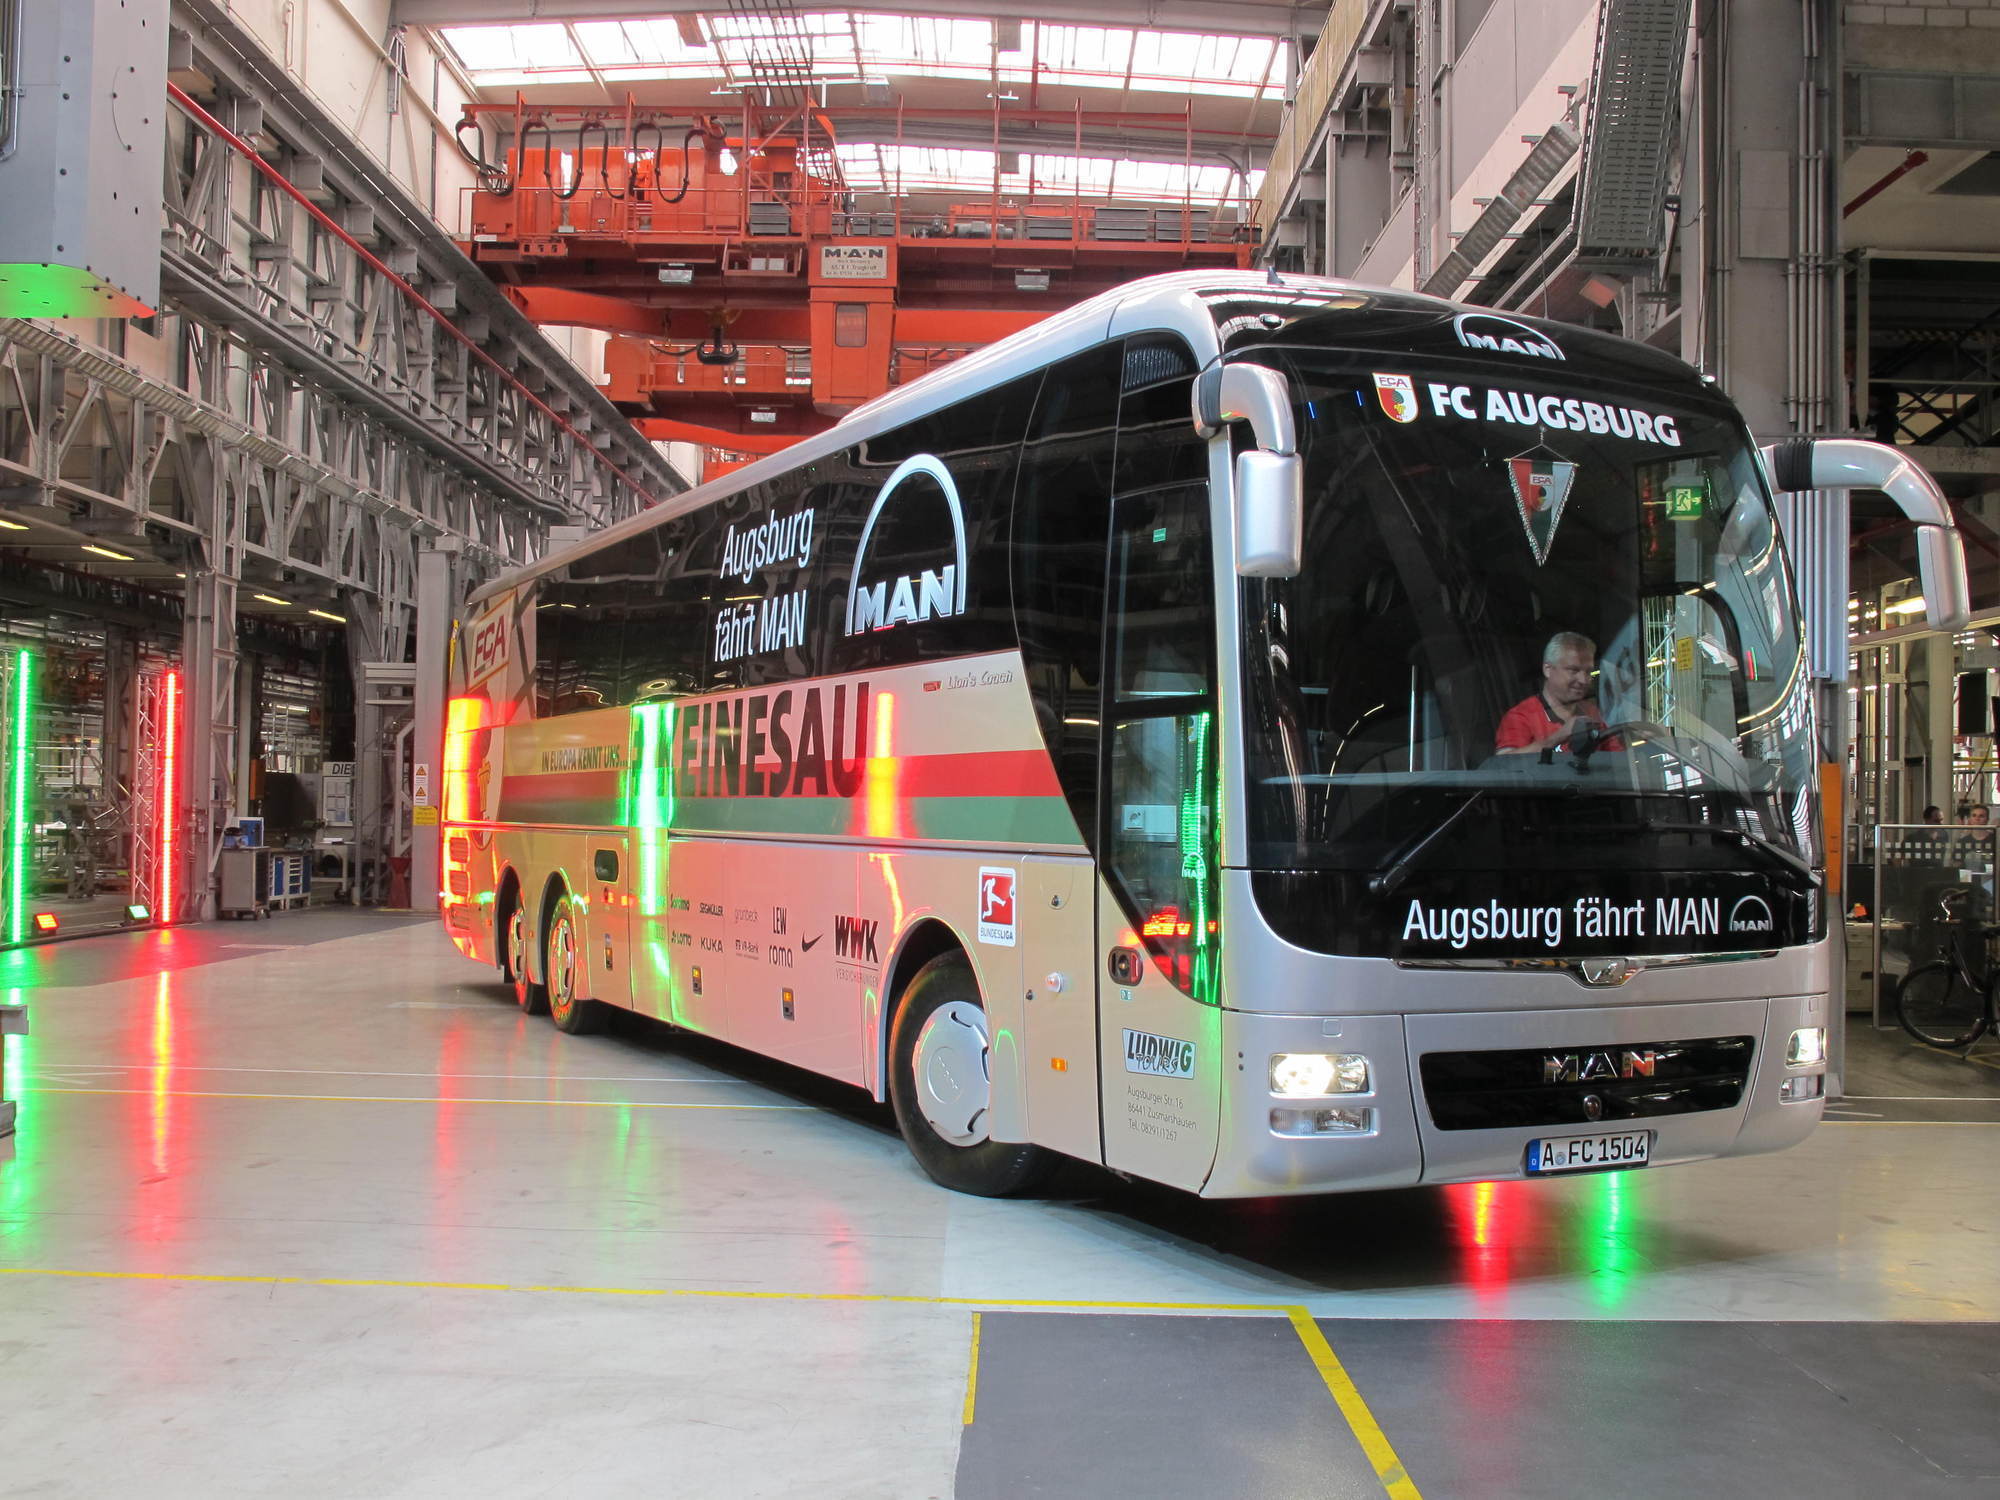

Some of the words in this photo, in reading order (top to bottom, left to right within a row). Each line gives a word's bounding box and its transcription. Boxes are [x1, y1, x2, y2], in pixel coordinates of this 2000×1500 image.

[1466, 332, 1556, 358] MAN
[1428, 383, 1478, 420] FC
[1486, 389, 1681, 447] AUGSBURG
[720, 508, 815, 584] Augsburg
[855, 564, 956, 635] MAN
[474, 615, 506, 669] FCA
[714, 604, 756, 662] fährt
[760, 590, 807, 653] MAN
[947, 671, 977, 690] Lion's
[980, 670, 1013, 686] Coach
[550, 748, 577, 772] EUROPA
[578, 745, 603, 771] KENNT
[772, 906, 787, 935] LEW
[980, 926, 1014, 940] BUNDESLIGA
[1402, 899, 1562, 949] Augsburg
[1574, 897, 1645, 937] fährt
[1656, 897, 1720, 936] MAN
[1734, 919, 1770, 931] MAN
[700, 936, 724, 953] KUKA
[835, 915, 879, 963] WWK
[769, 945, 793, 968] roma
[1127, 1031, 1193, 1072] LUDWIG
[1136, 1054, 1180, 1074] TOURS
[1543, 1050, 1656, 1083] MAN
[1542, 1142, 1554, 1167] A
[1568, 1139, 1593, 1164] FC
[1598, 1135, 1645, 1161] 1504
